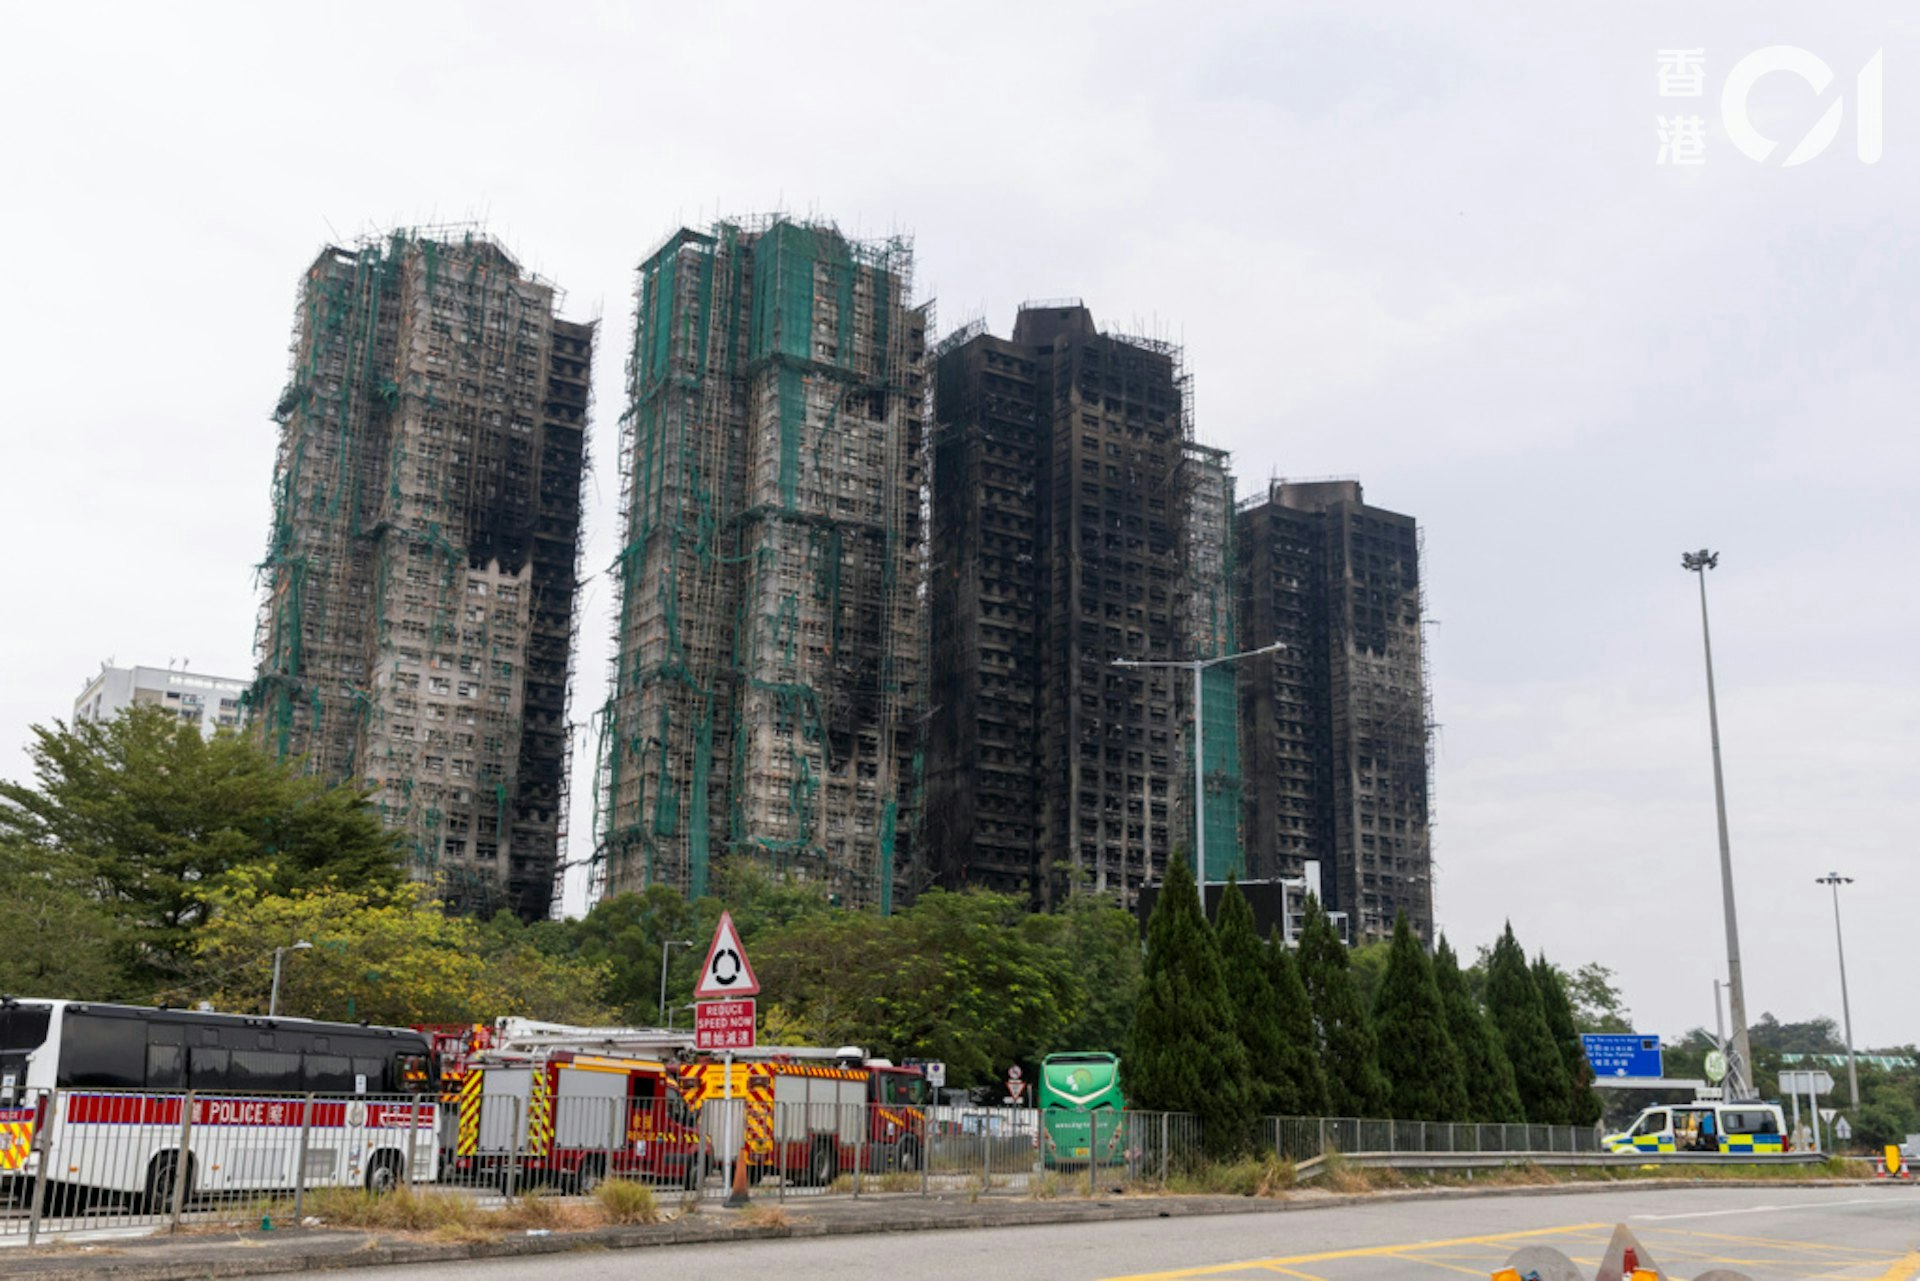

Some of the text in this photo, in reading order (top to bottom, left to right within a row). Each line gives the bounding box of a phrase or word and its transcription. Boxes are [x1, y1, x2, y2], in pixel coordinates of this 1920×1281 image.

[706, 1003, 743, 1016] REDUCE
[698, 1016, 752, 1029] SPEED NOW
[209, 1102, 265, 1123] POLICE
